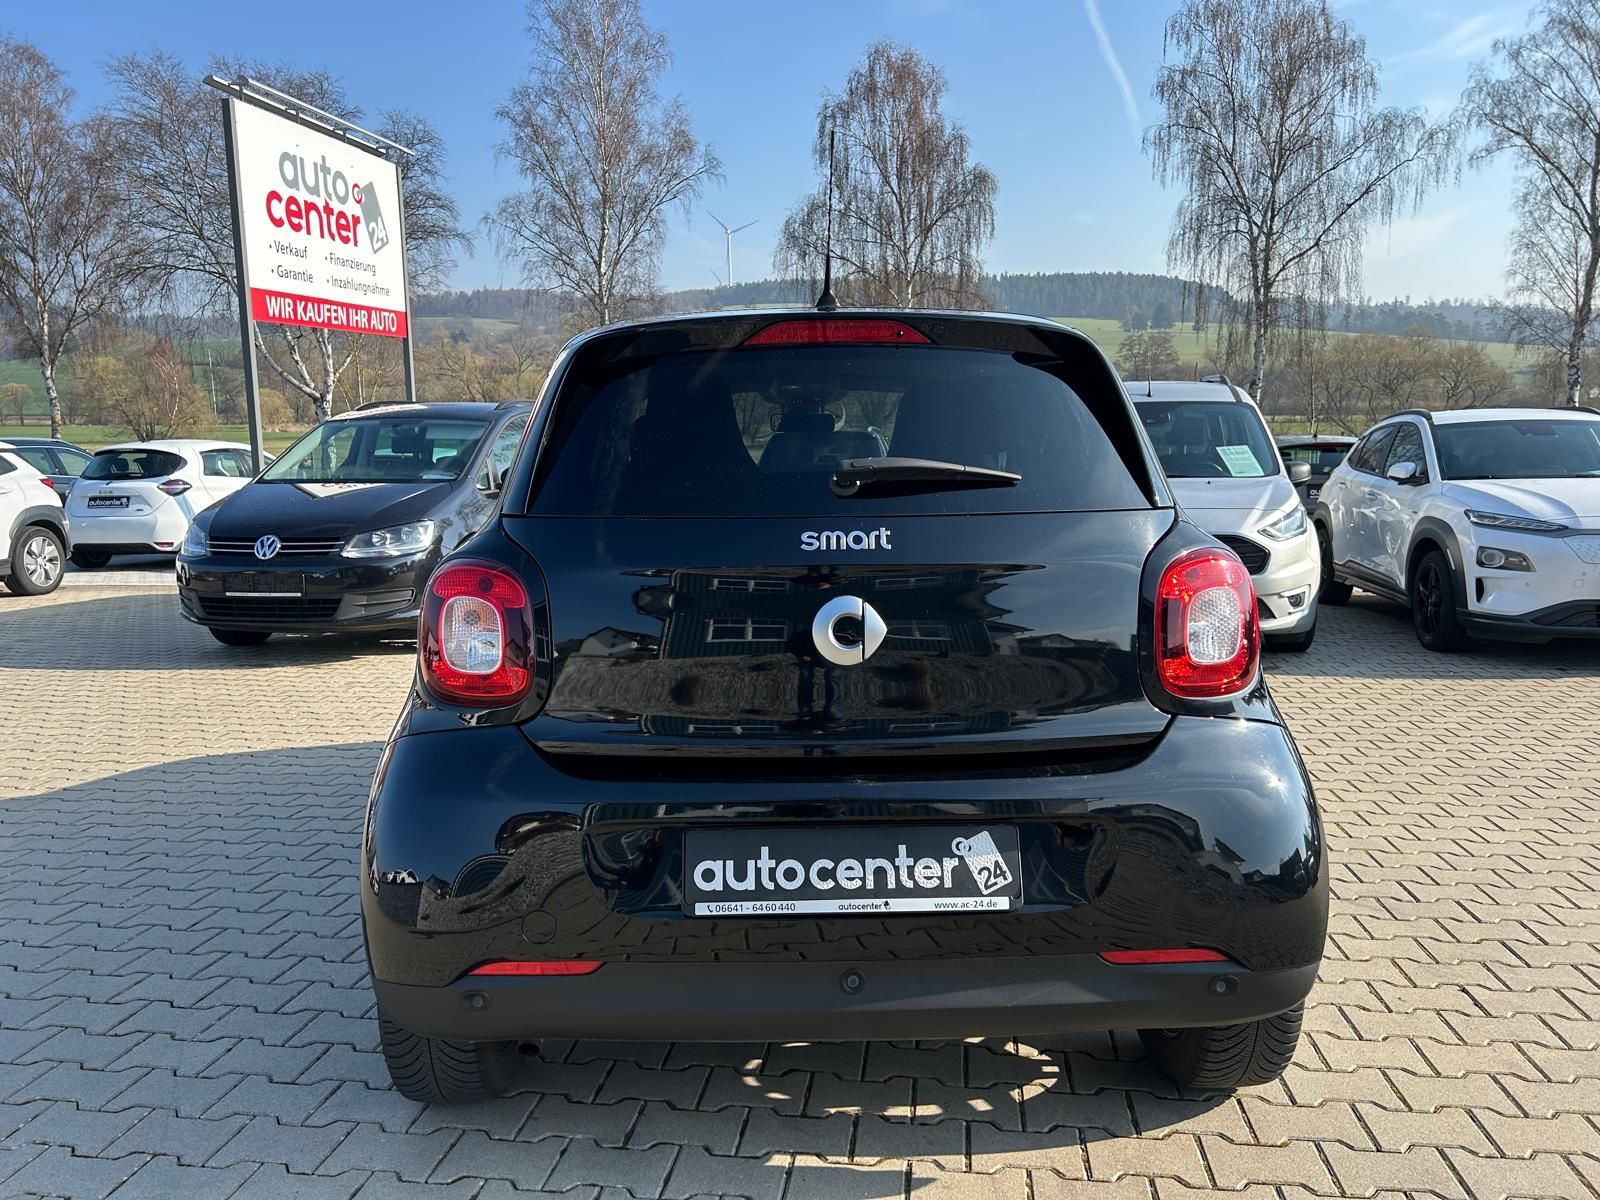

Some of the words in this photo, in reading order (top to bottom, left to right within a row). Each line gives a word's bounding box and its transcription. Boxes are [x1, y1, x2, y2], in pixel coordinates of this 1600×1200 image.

[279, 151, 349, 205] auto
[266, 190, 360, 247] center
[369, 216, 388, 248] 24
[274, 240, 307, 259] Verkauf
[277, 265, 313, 283] Garantie
[329, 252, 376, 276] Finanzierung
[331, 275, 390, 296] Inzahlungnahme
[265, 294, 295, 320] WIR
[296, 300, 346, 326] KAUFEN
[349, 308, 368, 329] IHR
[370, 310, 398, 333] AUTO
[800, 527, 892, 550] smart
[977, 859, 1008, 891] 24
[715, 904, 744, 913] 06641
[838, 902, 882, 911] autocenter
[934, 900, 998, 909] www.ac-24.de
